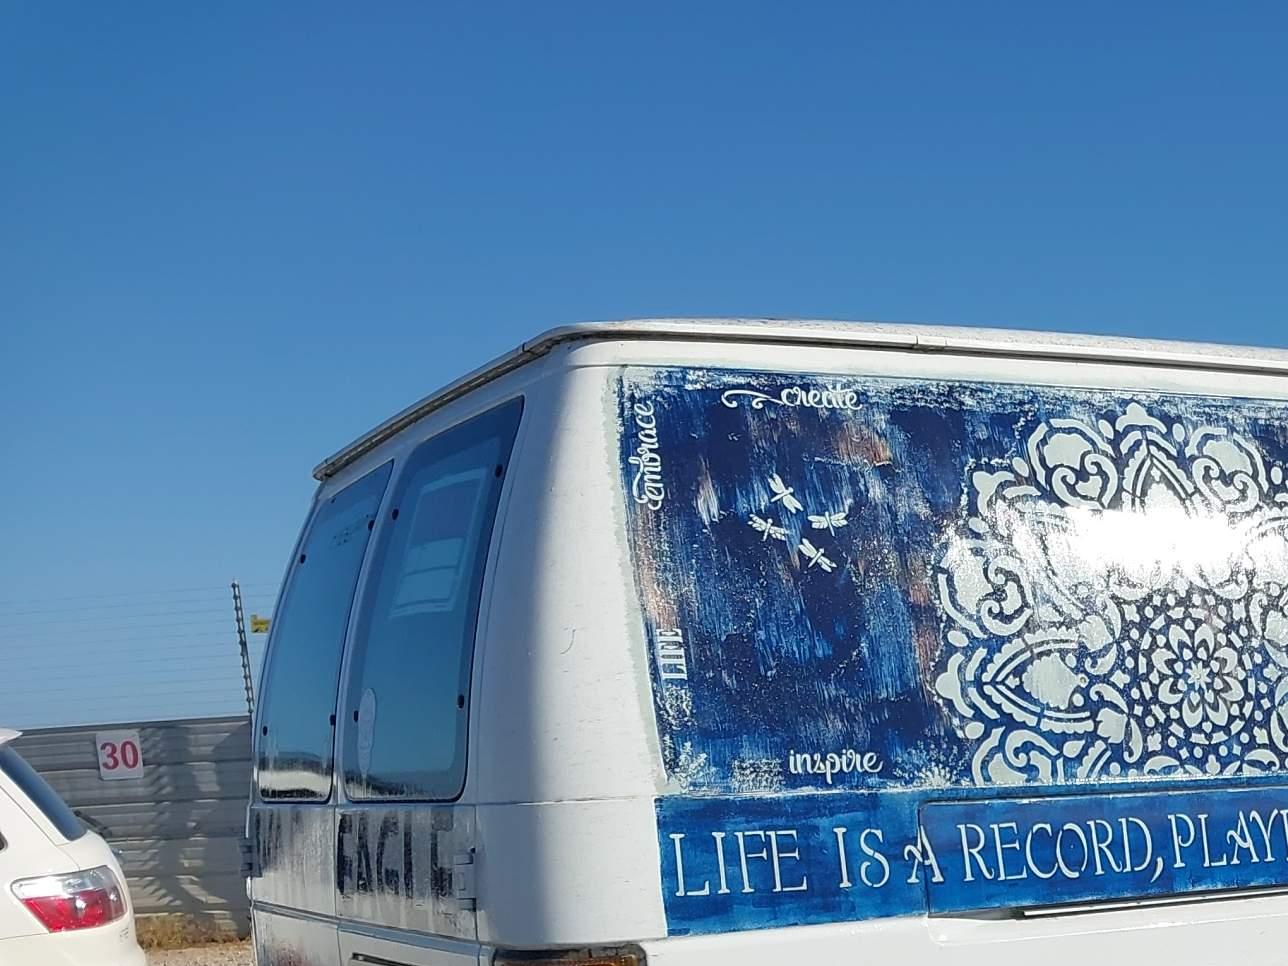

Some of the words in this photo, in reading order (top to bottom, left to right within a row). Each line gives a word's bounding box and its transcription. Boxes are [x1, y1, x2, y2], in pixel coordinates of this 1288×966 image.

[722, 386, 862, 410] create
[629, 400, 665, 511] embrace
[656, 628, 688, 680] LIFE
[100, 740, 139, 771] 30
[788, 750, 882, 784] inspire
[669, 829, 807, 897] LIFE
[834, 827, 889, 888] IS
[904, 825, 944, 884] A
[957, 815, 1163, 883] RECORD,
